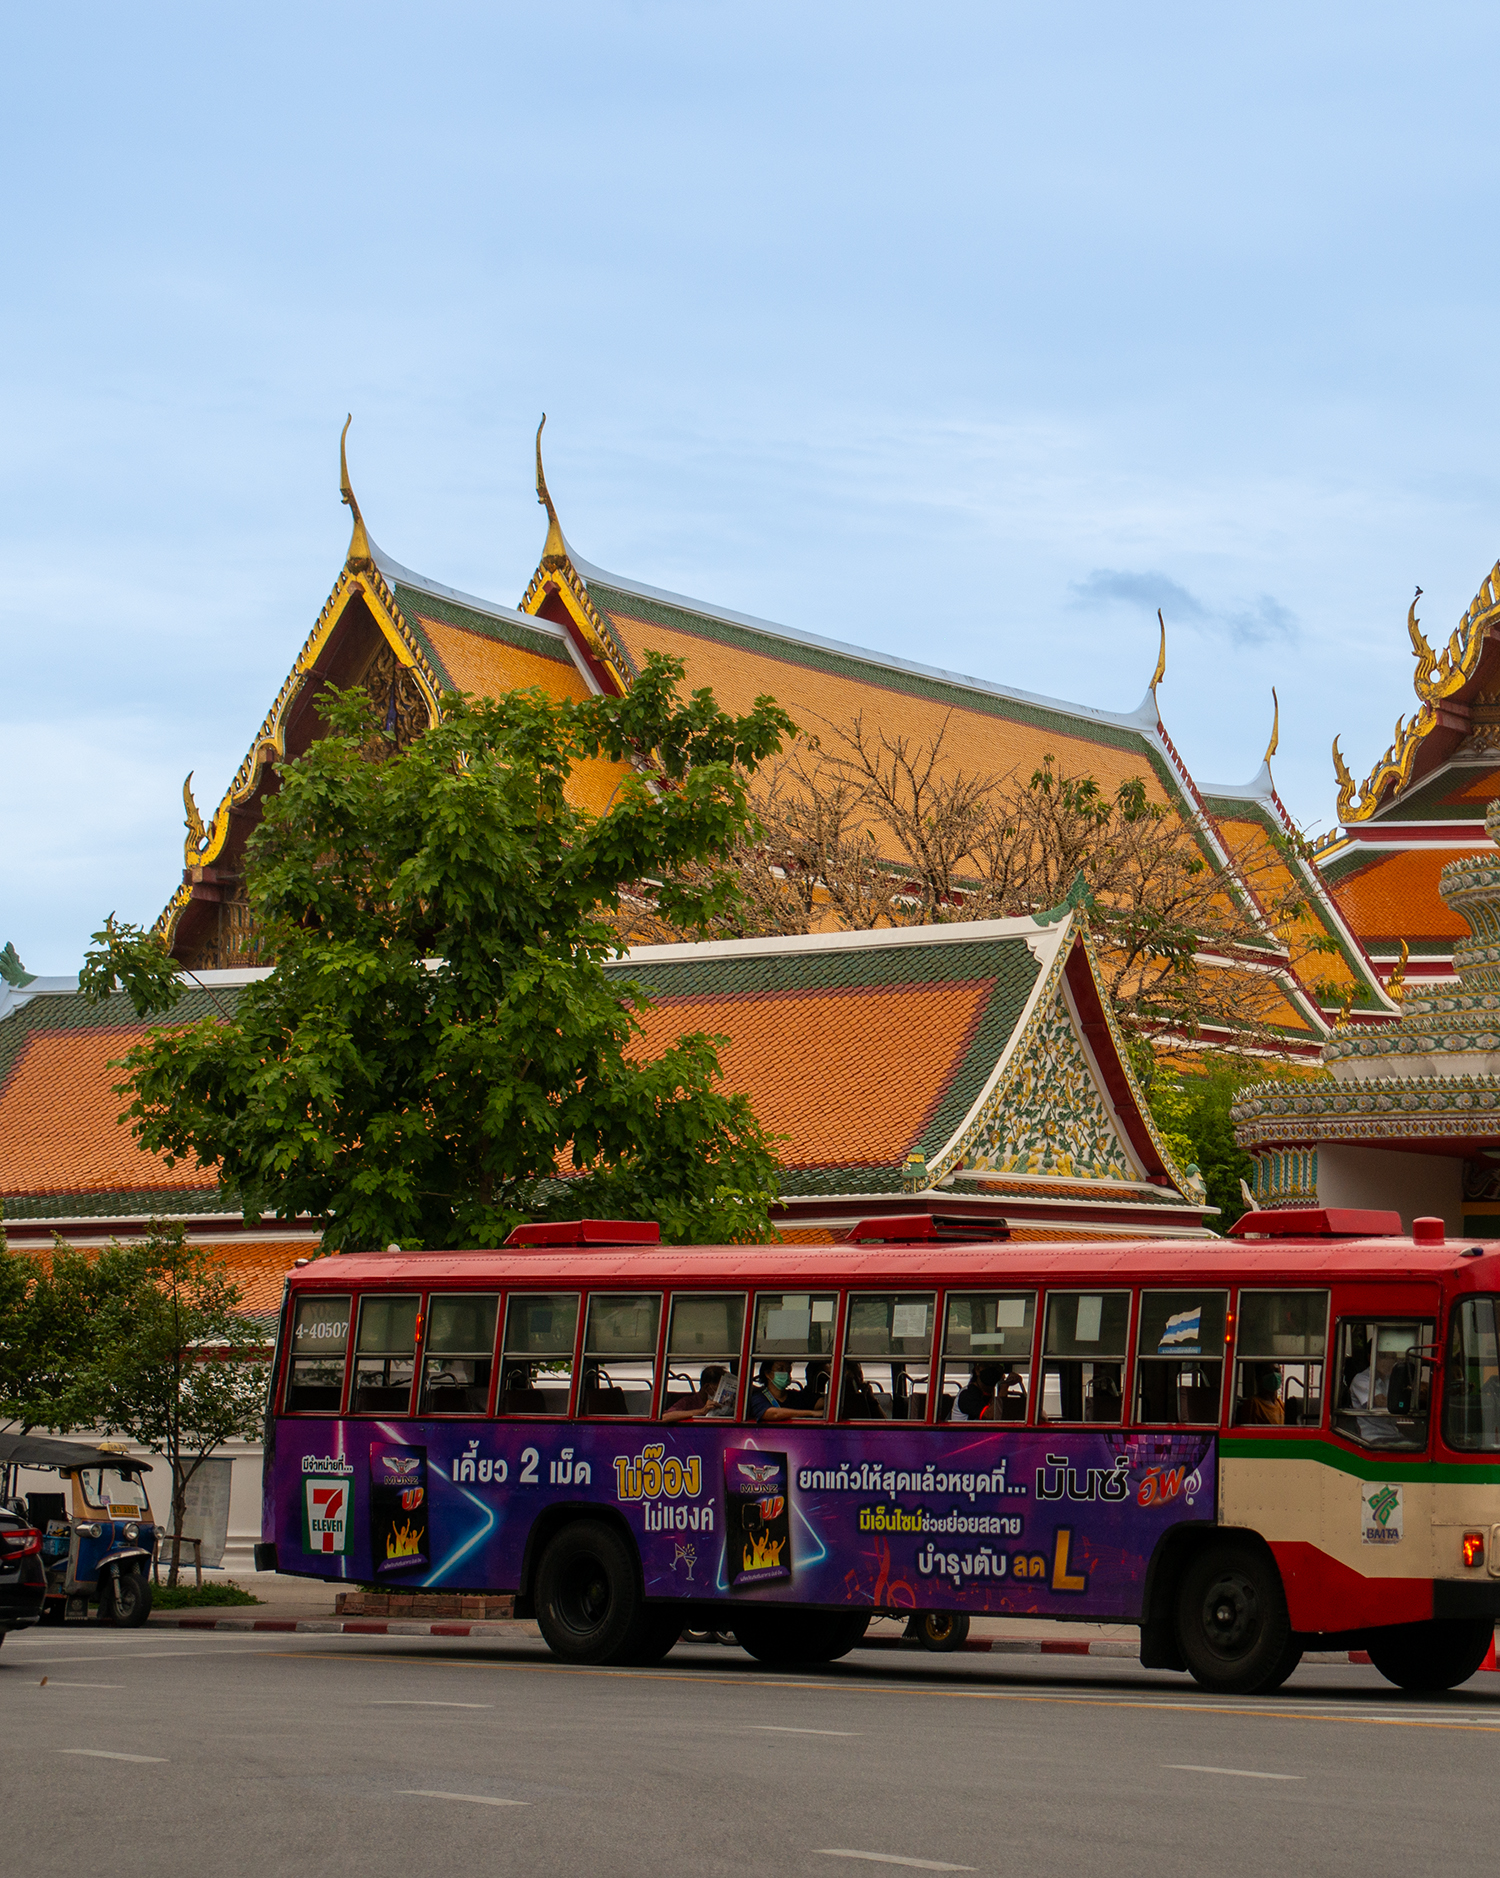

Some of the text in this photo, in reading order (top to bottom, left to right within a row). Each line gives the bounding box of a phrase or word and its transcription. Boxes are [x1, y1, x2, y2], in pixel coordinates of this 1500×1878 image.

[295, 1321, 349, 1339] 4-40507
[302, 1453, 354, 1472] มีจำหน่ายที่...
[453, 1440, 591, 1484] เคี้ยว 2 เม็ด
[384, 1475, 419, 1485] MUNZ
[740, 1483, 779, 1493] MUNZ
[799, 1453, 1186, 1507] ยกแก้วให้สุดแล้วหยุดที่... มันซ์ อัพ
[402, 1487, 424, 1511] UP
[760, 1496, 785, 1520] UP
[313, 1488, 343, 1552] 7
[643, 1498, 715, 1531] ไม่แฮงค์
[1366, 1528, 1399, 1539] BMTA
[918, 1530, 1085, 1590] บำรุงตับ ลด L
